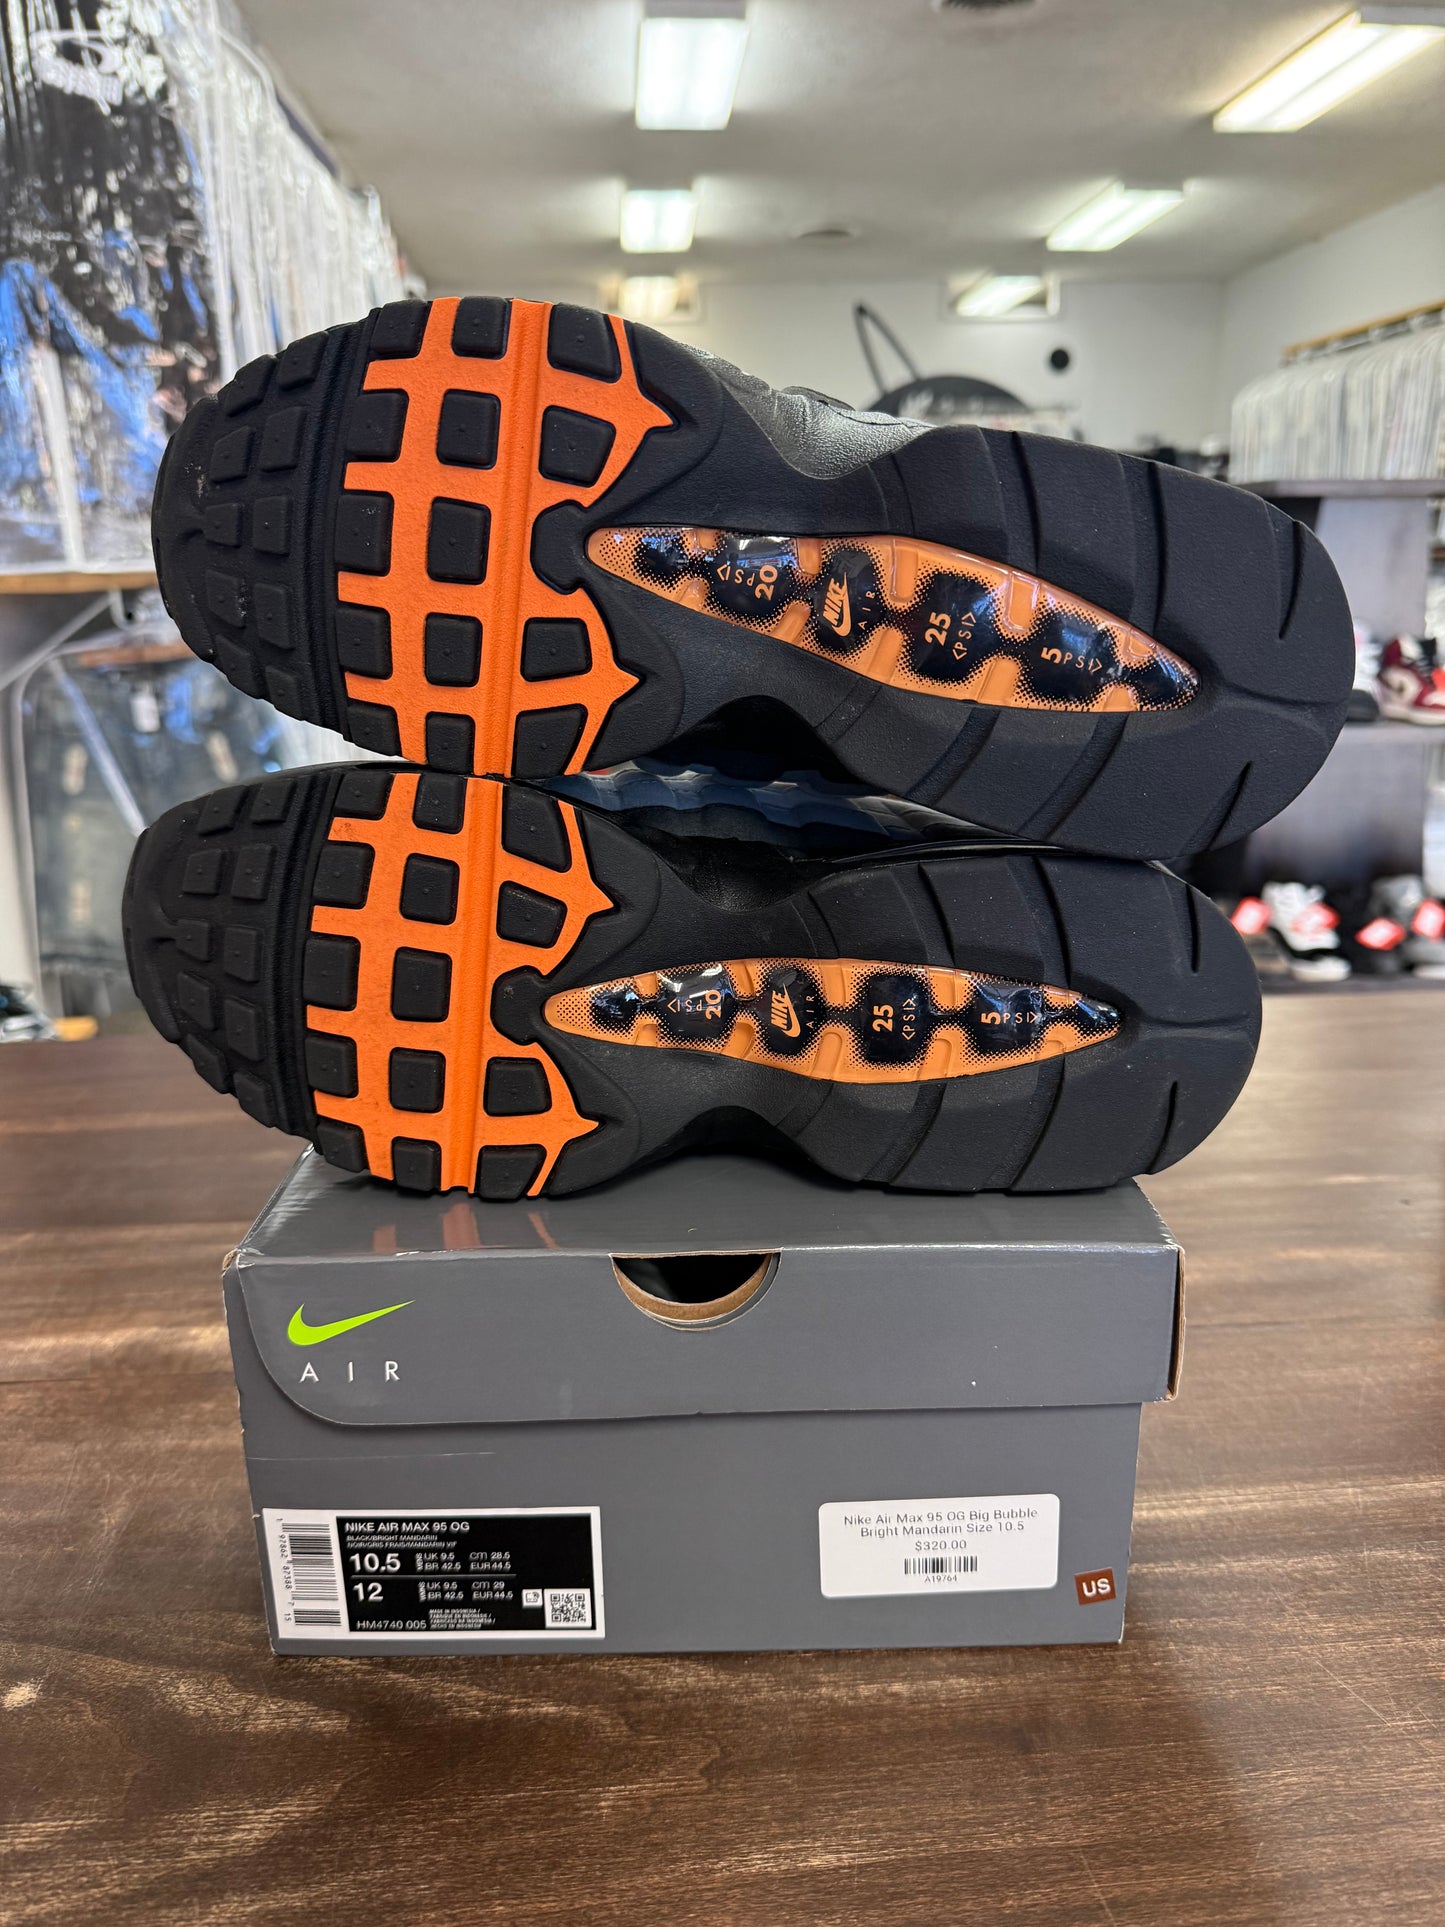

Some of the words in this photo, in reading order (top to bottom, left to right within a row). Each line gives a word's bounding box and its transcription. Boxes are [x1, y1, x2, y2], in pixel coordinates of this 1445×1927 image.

[755, 564, 778, 600] 20
[822, 578, 846, 626] NIKE
[857, 590, 875, 630] AIR
[924, 611, 951, 646] 25
[1040, 647, 1062, 664] 5
[705, 989, 722, 1020] 20
[770, 990, 789, 1030] NIKE
[805, 995, 815, 1029] AIR
[872, 1004, 894, 1032] 25
[980, 1012, 1001, 1025] 5
[299, 1360, 400, 1383] AIR
[844, 1514, 872, 1526] Nike
[875, 1513, 891, 1525] Air
[896, 1513, 923, 1524] Max
[926, 1511, 943, 1522] 95
[946, 1511, 965, 1521] OG
[969, 1509, 990, 1522] Big
[993, 1507, 1038, 1520] Bubble
[345, 1522, 375, 1533] NIKE
[378, 1522, 399, 1532] AIR
[401, 1522, 430, 1532] MAX
[432, 1522, 448, 1531] 95
[450, 1521, 470, 1532] OG
[860, 1525, 899, 1538] Bright
[902, 1524, 962, 1536] Mandarin
[966, 1522, 993, 1533] Size
[998, 1520, 1025, 1532] 10.5
[914, 1539, 967, 1552] $320.00
[349, 1552, 401, 1572] 10.5
[424, 1552, 439, 1560] UK
[440, 1552, 456, 1560] 9.5
[490, 1552, 511, 1560] 28.5
[424, 1562, 440, 1570] BR
[441, 1562, 462, 1570] 42.5
[470, 1562, 491, 1570] EUR
[491, 1561, 512, 1570] 44.5
[353, 1582, 384, 1601] 12
[443, 1581, 458, 1589] 9.5
[493, 1581, 505, 1589] 29
[1082, 1577, 1111, 1598] US
[427, 1591, 442, 1599] BR
[444, 1591, 464, 1600] 42.5
[472, 1591, 493, 1599] EUR
[494, 1590, 514, 1599] 44.5
[356, 1620, 404, 1630] HM4740
[405, 1620, 427, 1629] 005
